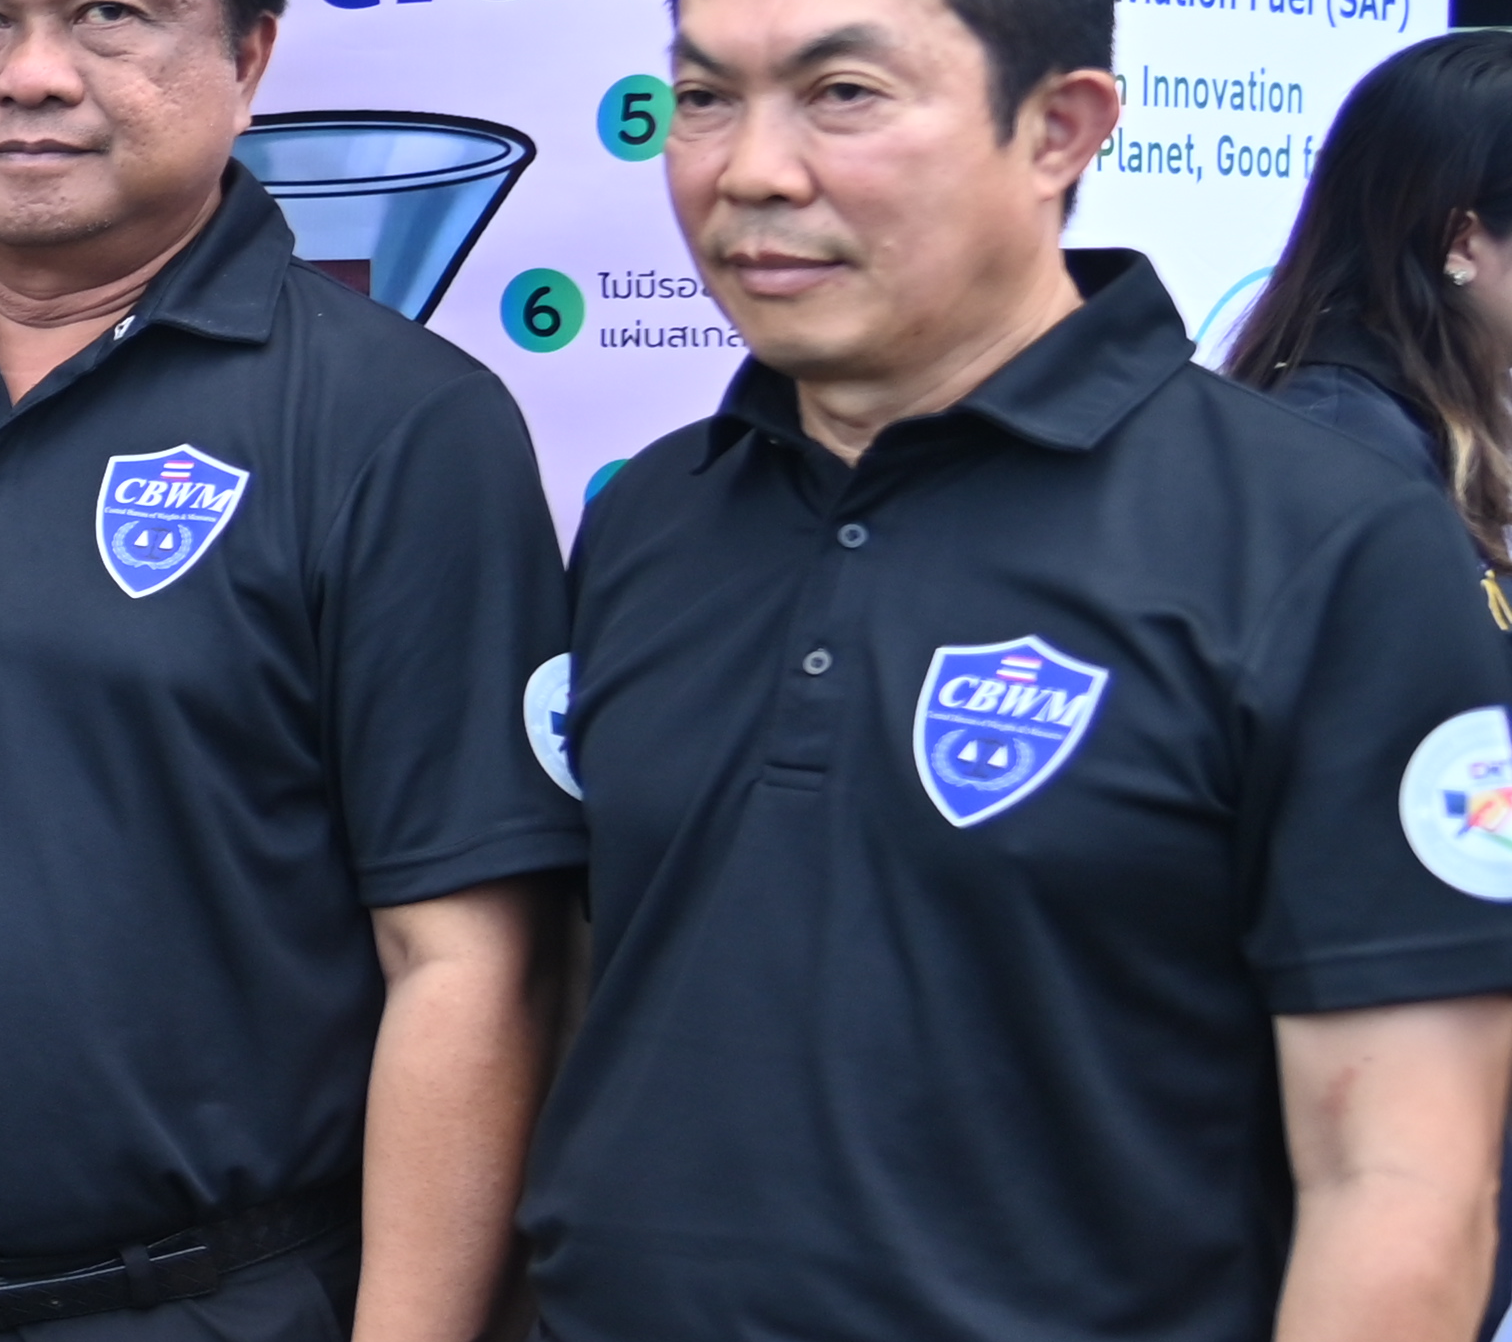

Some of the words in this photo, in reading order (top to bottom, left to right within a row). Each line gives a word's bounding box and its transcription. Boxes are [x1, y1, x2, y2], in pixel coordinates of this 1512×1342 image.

[1142, 65, 1303, 114] Innovation
[618, 92, 656, 145] 5
[1216, 135, 1291, 178] Good
[523, 286, 561, 337] 6
[115, 477, 236, 513] CBWM
[938, 674, 1090, 728] CBWM
